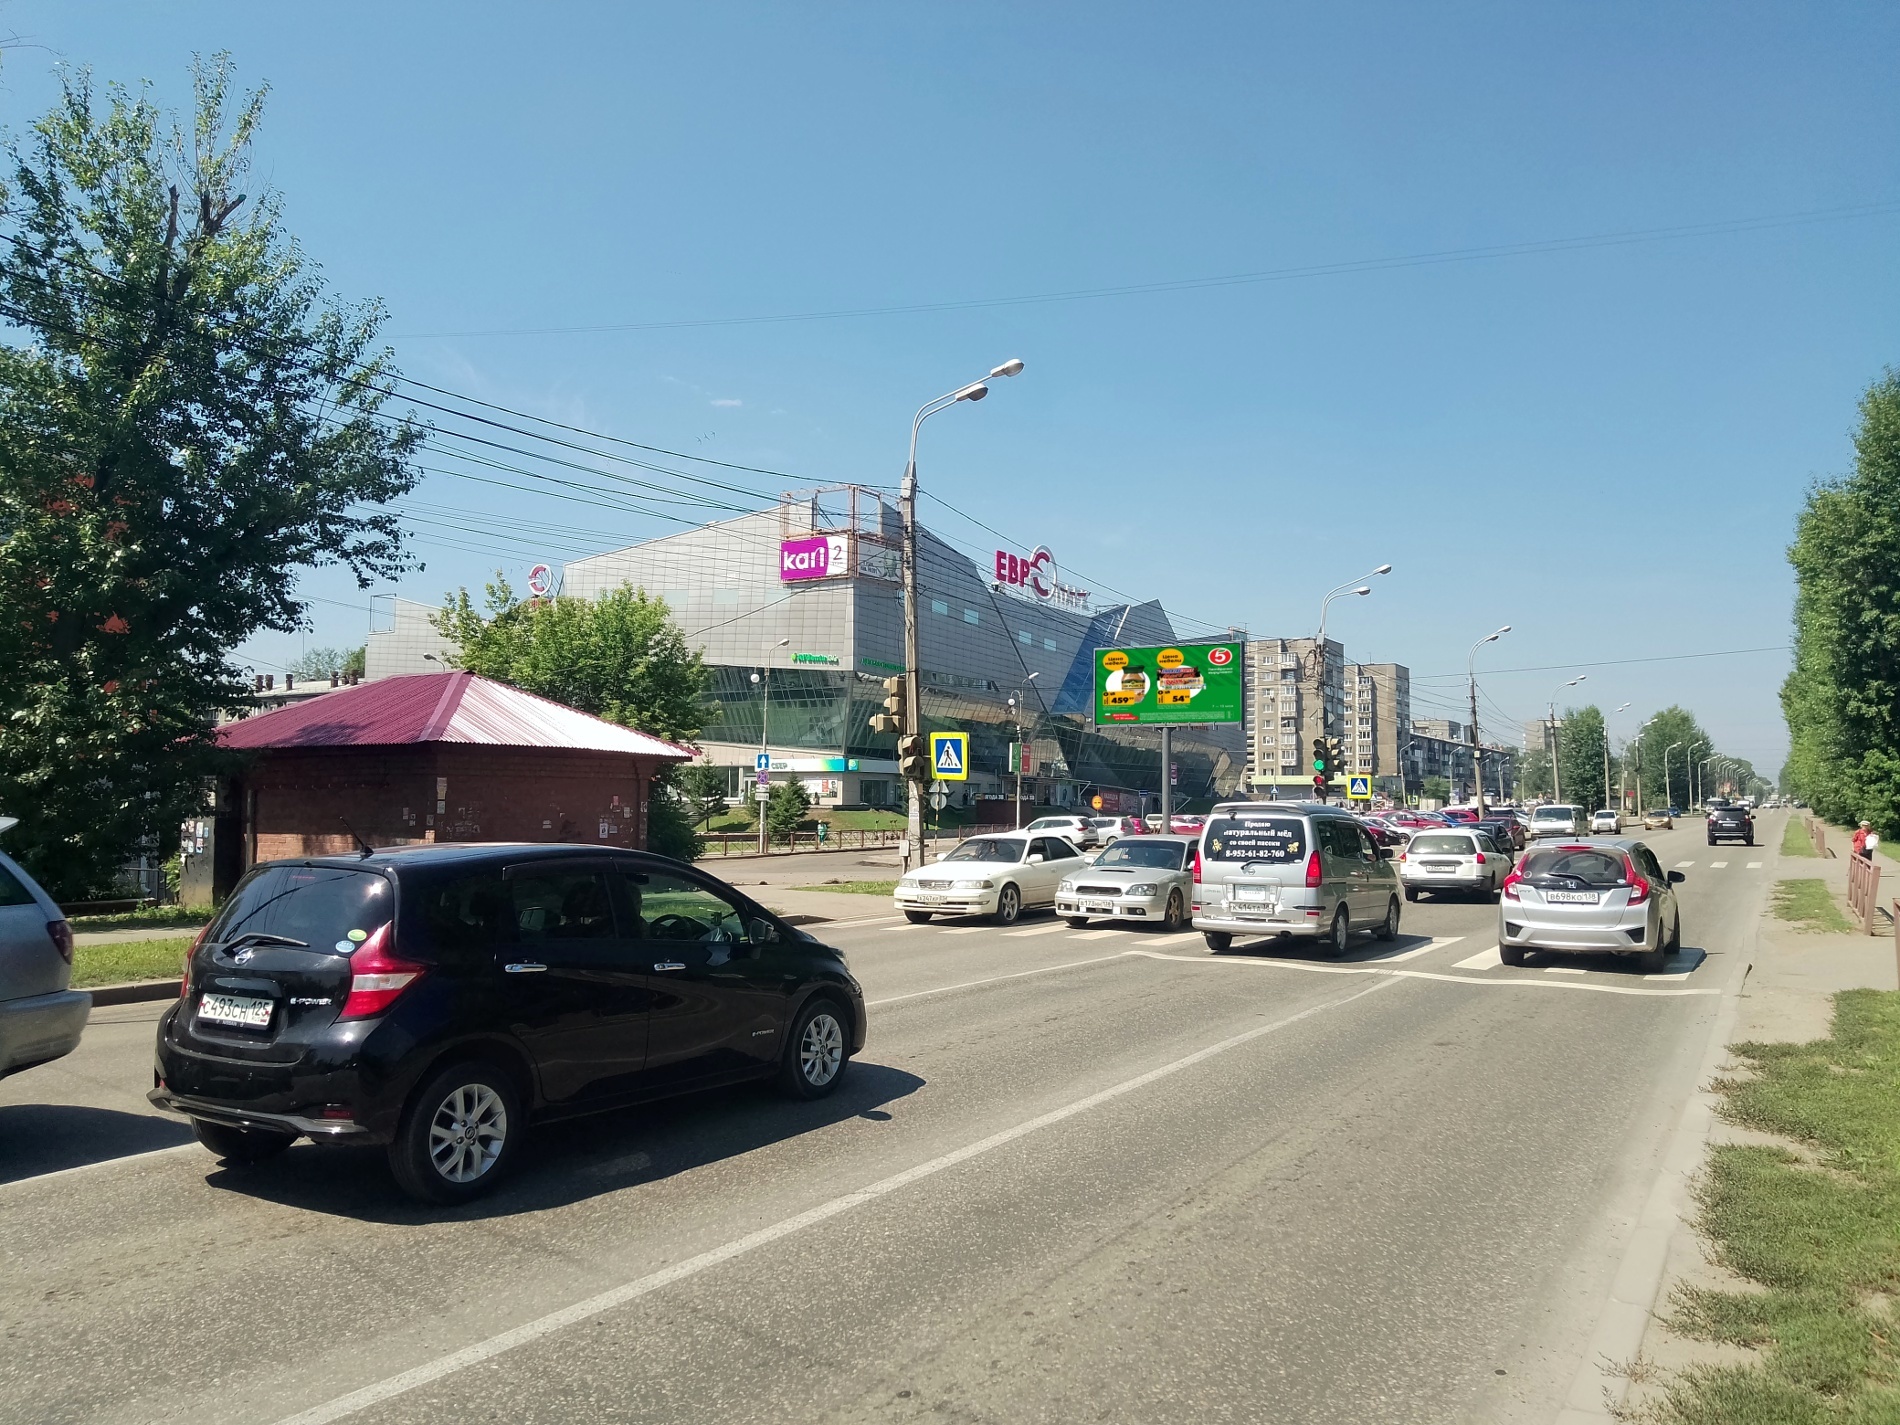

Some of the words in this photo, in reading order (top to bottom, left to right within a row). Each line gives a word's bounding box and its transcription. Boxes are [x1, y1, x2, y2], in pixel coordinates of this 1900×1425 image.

[833, 545, 842, 560] 2
[783, 547, 825, 571] kari
[1214, 650, 1226, 663] 5
[1111, 696, 1129, 704] 459
[1172, 695, 1185, 703] 54
[1223, 829, 1275, 837] натуральный
[1277, 830, 1292, 838] мёд
[1225, 850, 1285, 858] 8-952-61-82-760
[203, 996, 248, 1020] С493СН
[251, 1000, 270, 1017] 125
